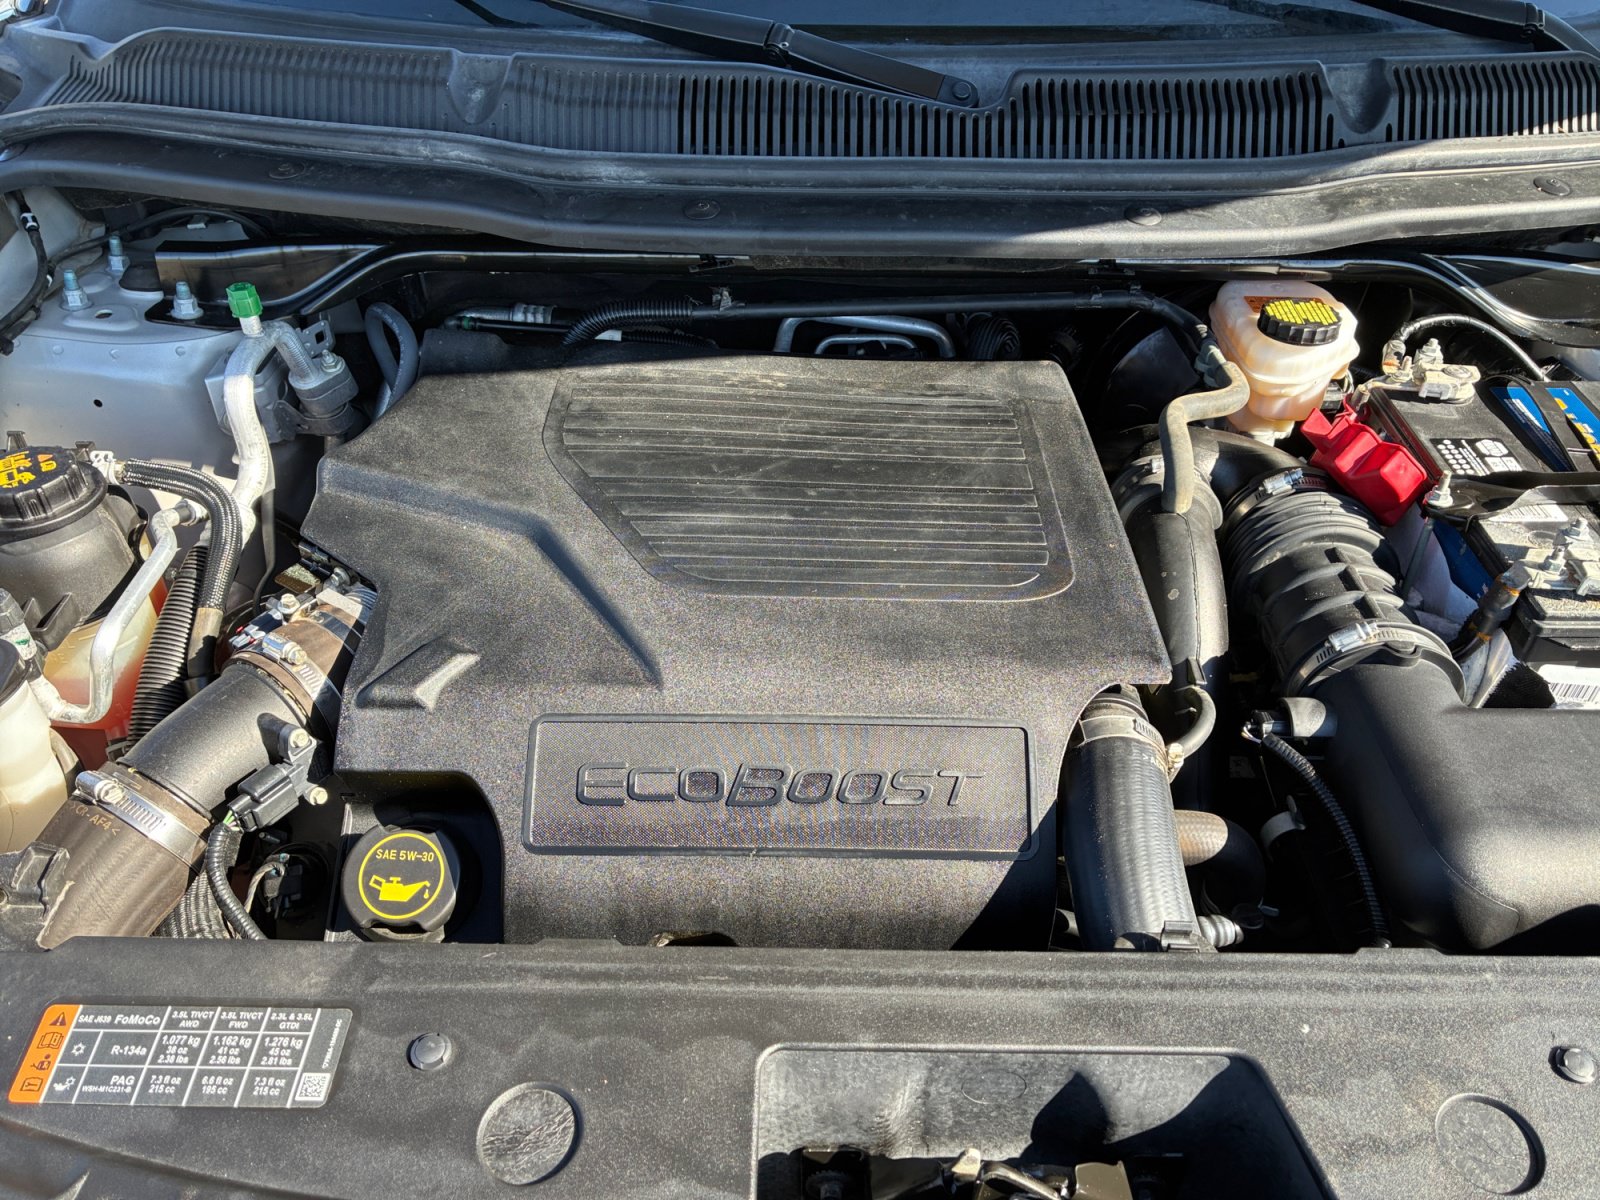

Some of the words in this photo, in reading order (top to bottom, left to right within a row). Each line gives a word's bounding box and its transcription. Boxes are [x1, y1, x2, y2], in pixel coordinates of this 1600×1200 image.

[376, 849, 397, 859] SAE
[399, 850, 434, 862] 5W-30
[78, 1014, 94, 1023] SAE
[114, 1014, 160, 1025] FoMoCo
[162, 1035, 187, 1045] 1.077
[188, 1036, 200, 1047] kg
[213, 1036, 238, 1045] 1.162
[239, 1036, 252, 1048] kg
[264, 1037, 289, 1047] 1.276
[290, 1037, 303, 1049] kg
[111, 1045, 147, 1055] R-134a
[166, 1046, 177, 1054] 38
[218, 1046, 228, 1054] 41
[269, 1048, 280, 1056] 45
[176, 1055, 188, 1064] lbs
[227, 1056, 240, 1064] lbs
[261, 1057, 278, 1065] 2.81
[279, 1057, 292, 1065] lbs
[110, 1075, 135, 1085] PAG
[150, 1075, 163, 1084] 7.3
[171, 1077, 182, 1085] oz
[202, 1076, 215, 1085] 6.6
[223, 1078, 234, 1086] oz
[254, 1077, 267, 1086] 7.3
[275, 1079, 286, 1087] oz
[149, 1084, 164, 1093] 215
[202, 1085, 217, 1094] 195
[253, 1087, 269, 1095] 215
[269, 1088, 280, 1096] cc
